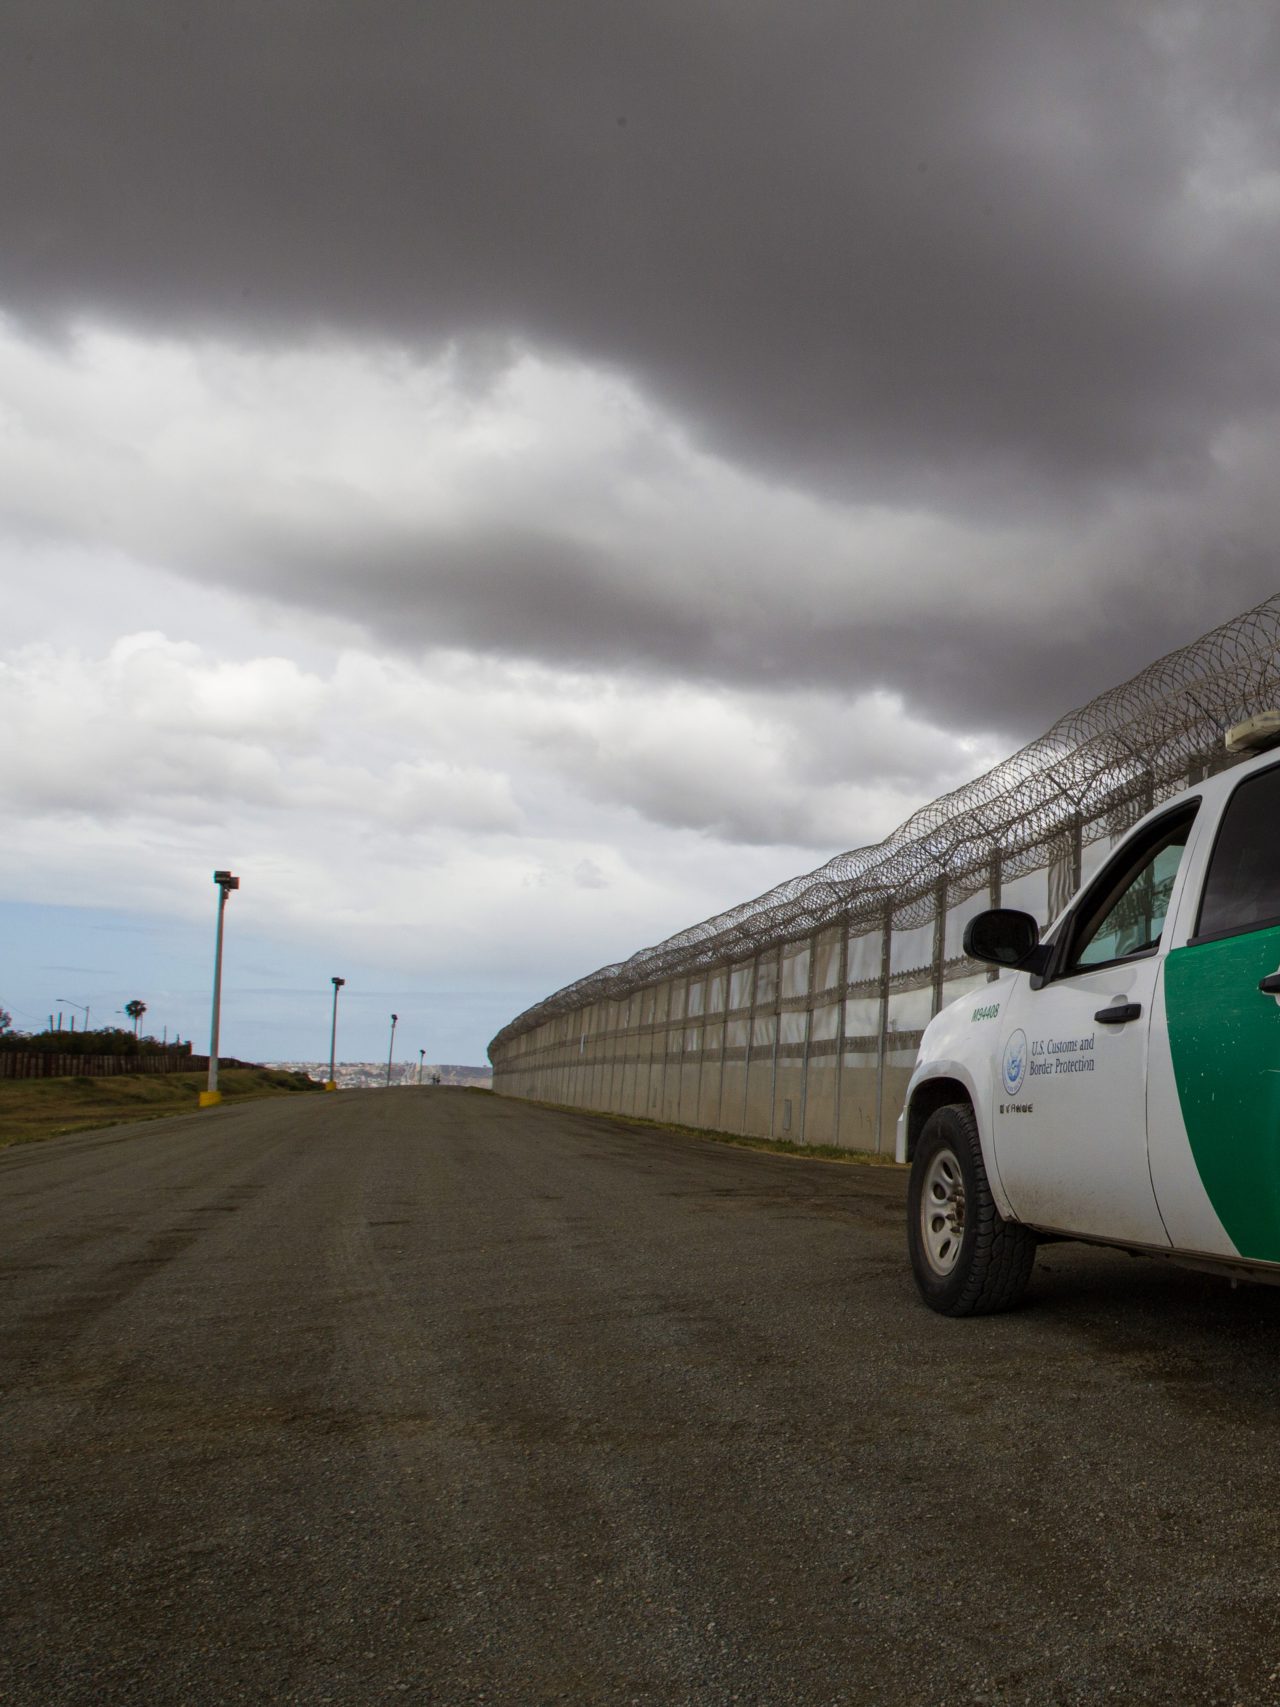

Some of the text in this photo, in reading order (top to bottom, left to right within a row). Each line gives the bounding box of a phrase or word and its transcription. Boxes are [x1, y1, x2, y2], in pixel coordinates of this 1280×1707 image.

[971, 1003, 1000, 1022] M94408
[1031, 1032, 1095, 1056] U.S. Customs and
[1029, 1055, 1095, 1076] Border Protection
